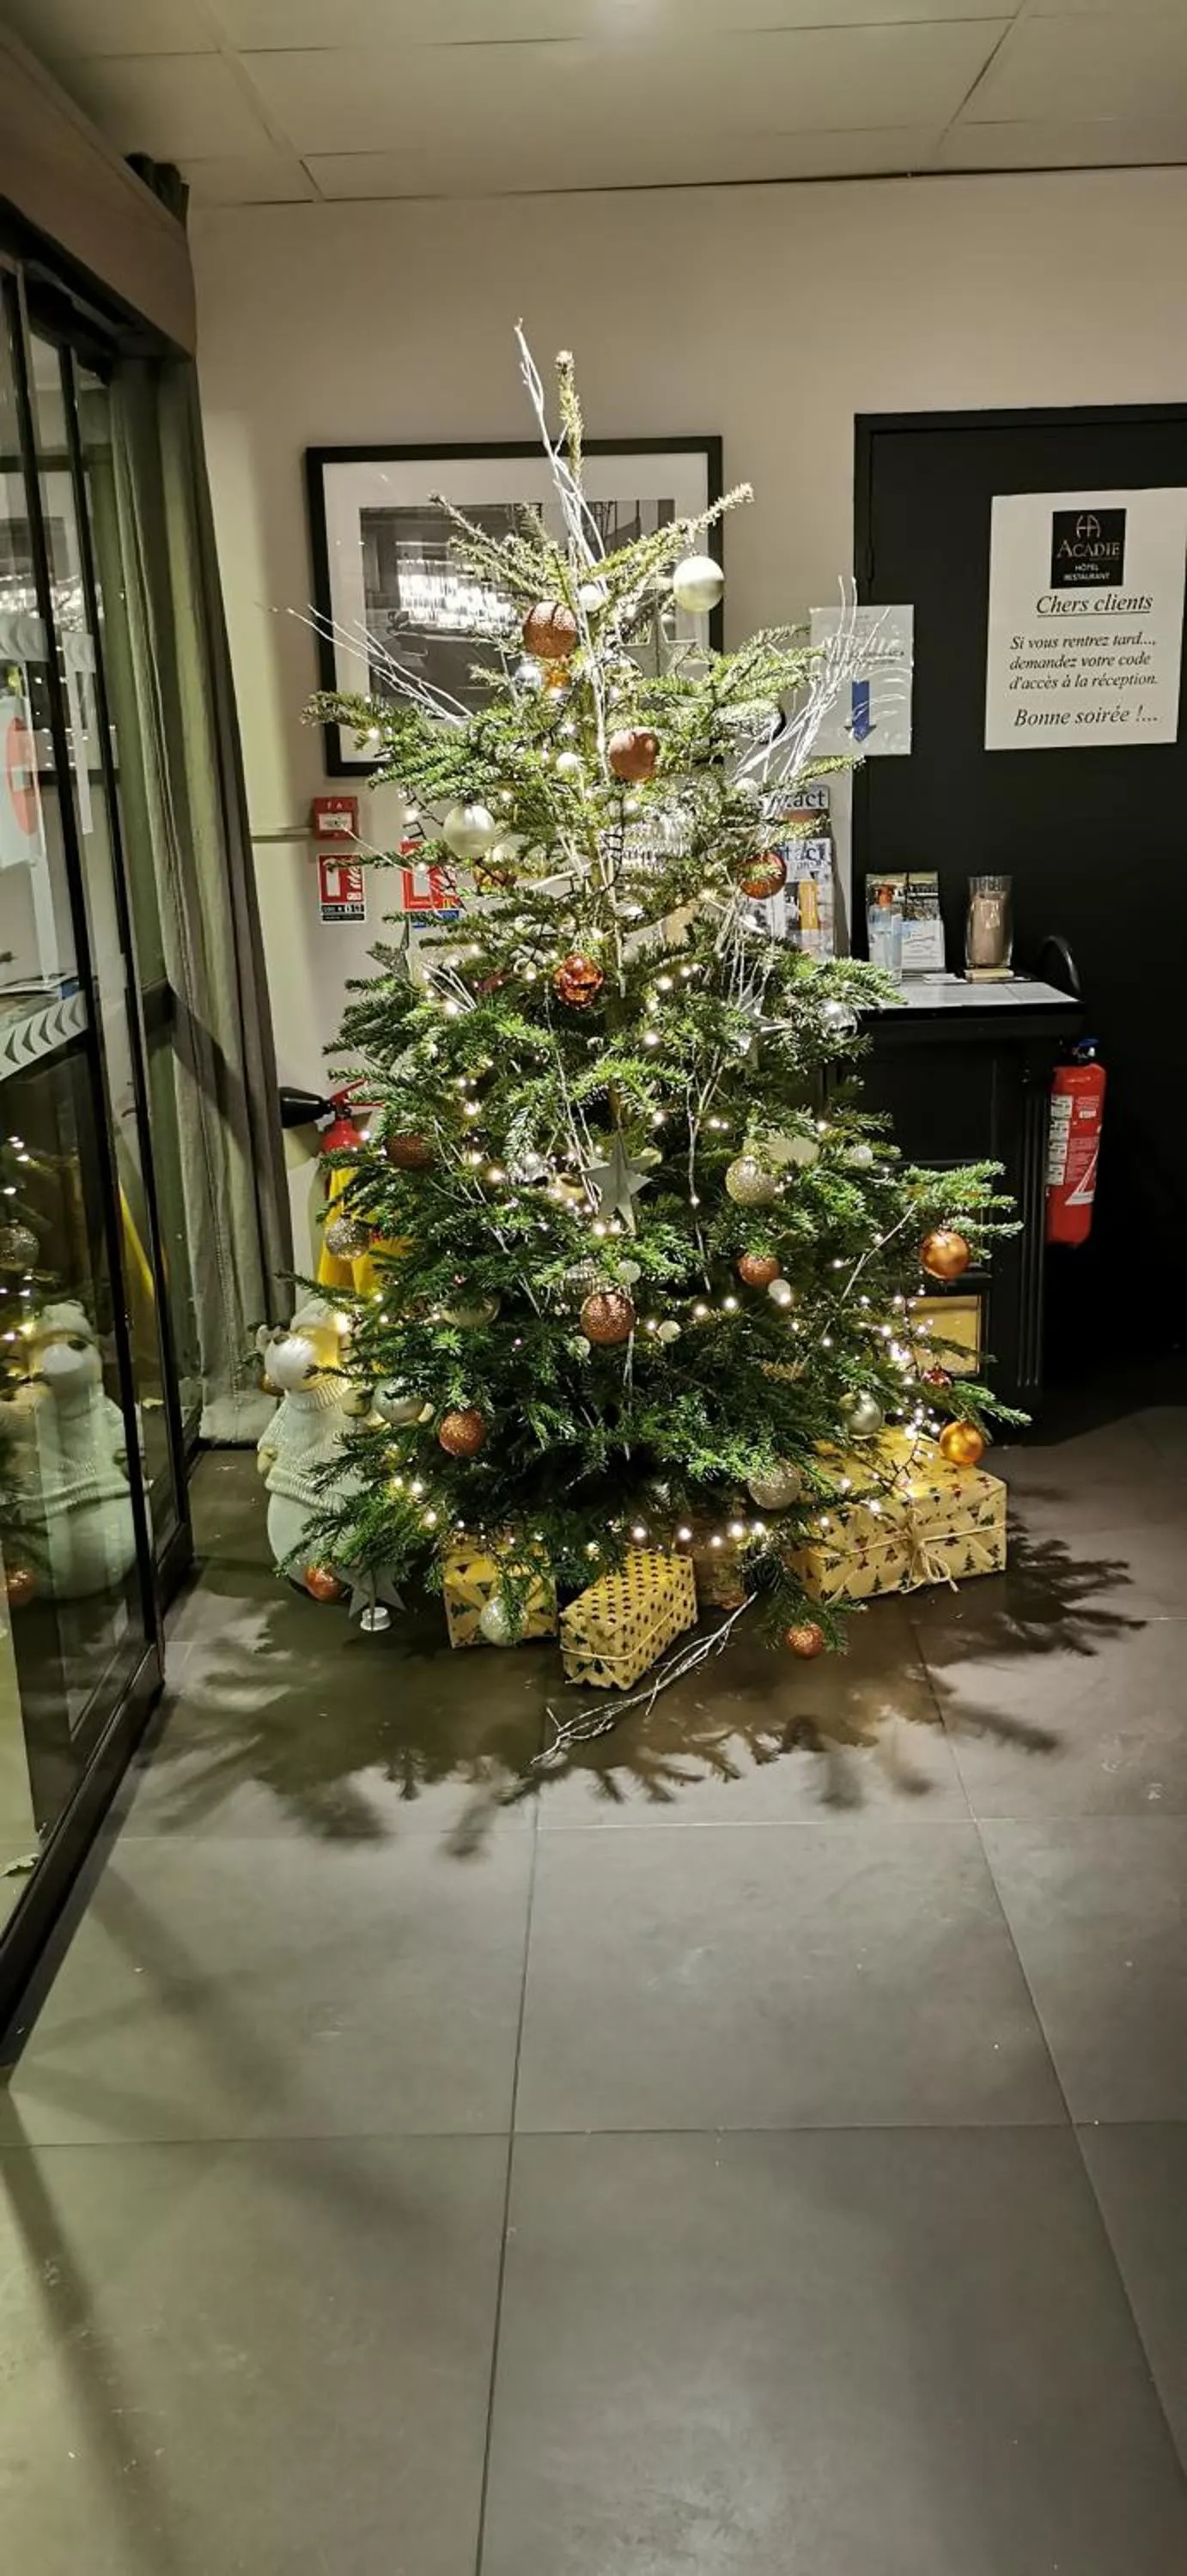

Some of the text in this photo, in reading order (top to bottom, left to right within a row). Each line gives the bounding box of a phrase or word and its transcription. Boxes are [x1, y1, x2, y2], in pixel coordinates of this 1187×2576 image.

[1037, 593, 1153, 614] Chers clients
[1010, 636, 1024, 649] Si
[1028, 638, 1058, 648] vous
[1062, 635, 1109, 647] rentrez
[1009, 651, 1151, 670] demandez votre code
[1009, 672, 1158, 690] d'accès à la réception.
[1014, 708, 1071, 726] Bonne
[1074, 705, 1129, 724] soirée
